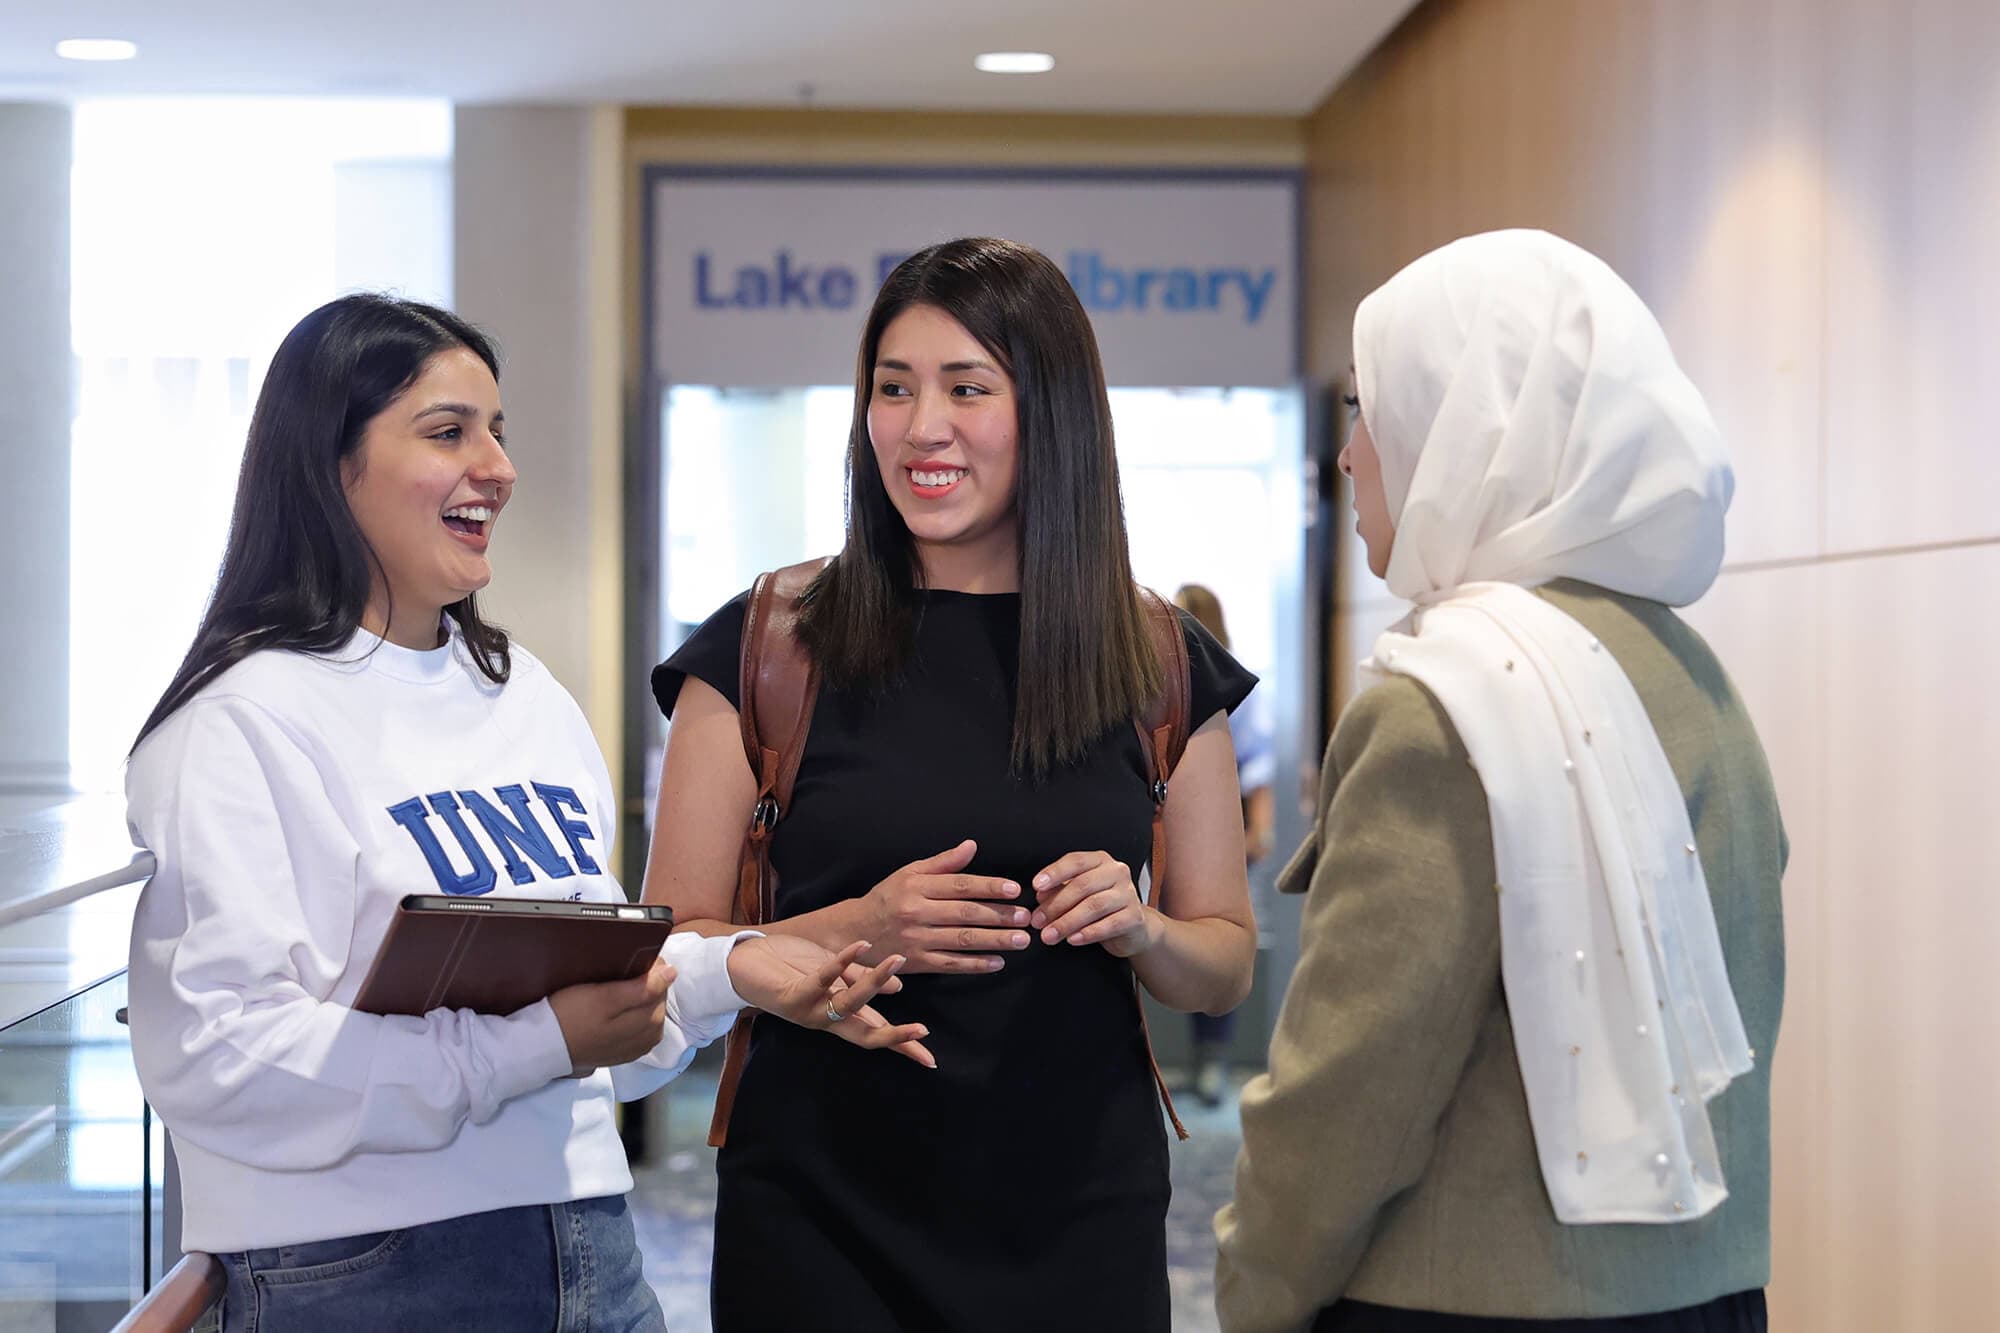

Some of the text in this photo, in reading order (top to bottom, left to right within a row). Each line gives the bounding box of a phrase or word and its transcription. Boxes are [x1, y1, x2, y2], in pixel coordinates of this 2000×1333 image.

[694, 251, 857, 309] Lake
[1067, 252, 1276, 324] ibrary
[386, 780, 603, 897] UNF
